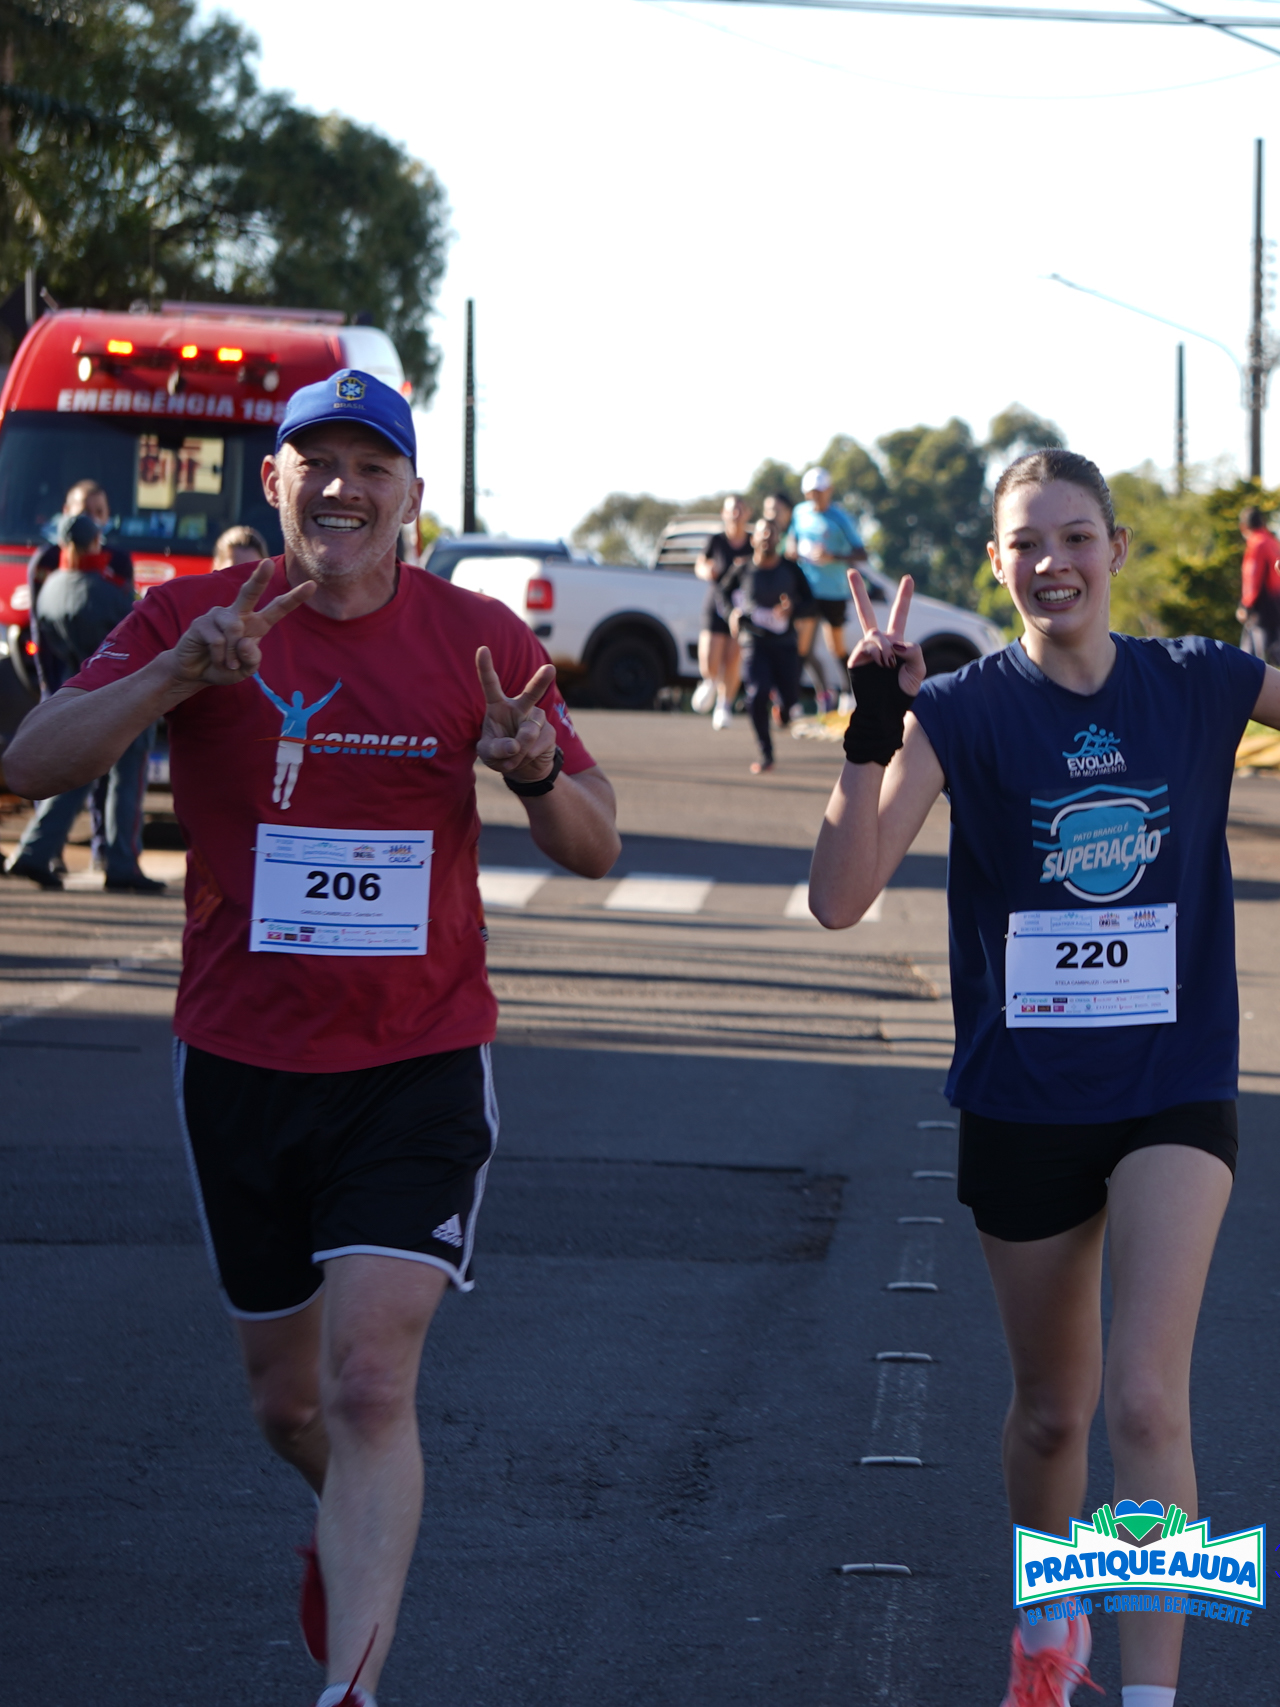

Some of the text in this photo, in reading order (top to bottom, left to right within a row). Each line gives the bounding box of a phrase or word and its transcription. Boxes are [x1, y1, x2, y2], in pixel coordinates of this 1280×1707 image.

[333, 402, 366, 411] BRASIL
[1067, 751, 1125, 772] EVOLUA
[1069, 764, 1127, 779] EM MOVIMENTO
[1073, 822, 1129, 843] PATO BRANCO É
[1042, 824, 1161, 880] SUPERAÇÃO
[305, 870, 382, 901] 206
[1055, 939, 1128, 969] 220
